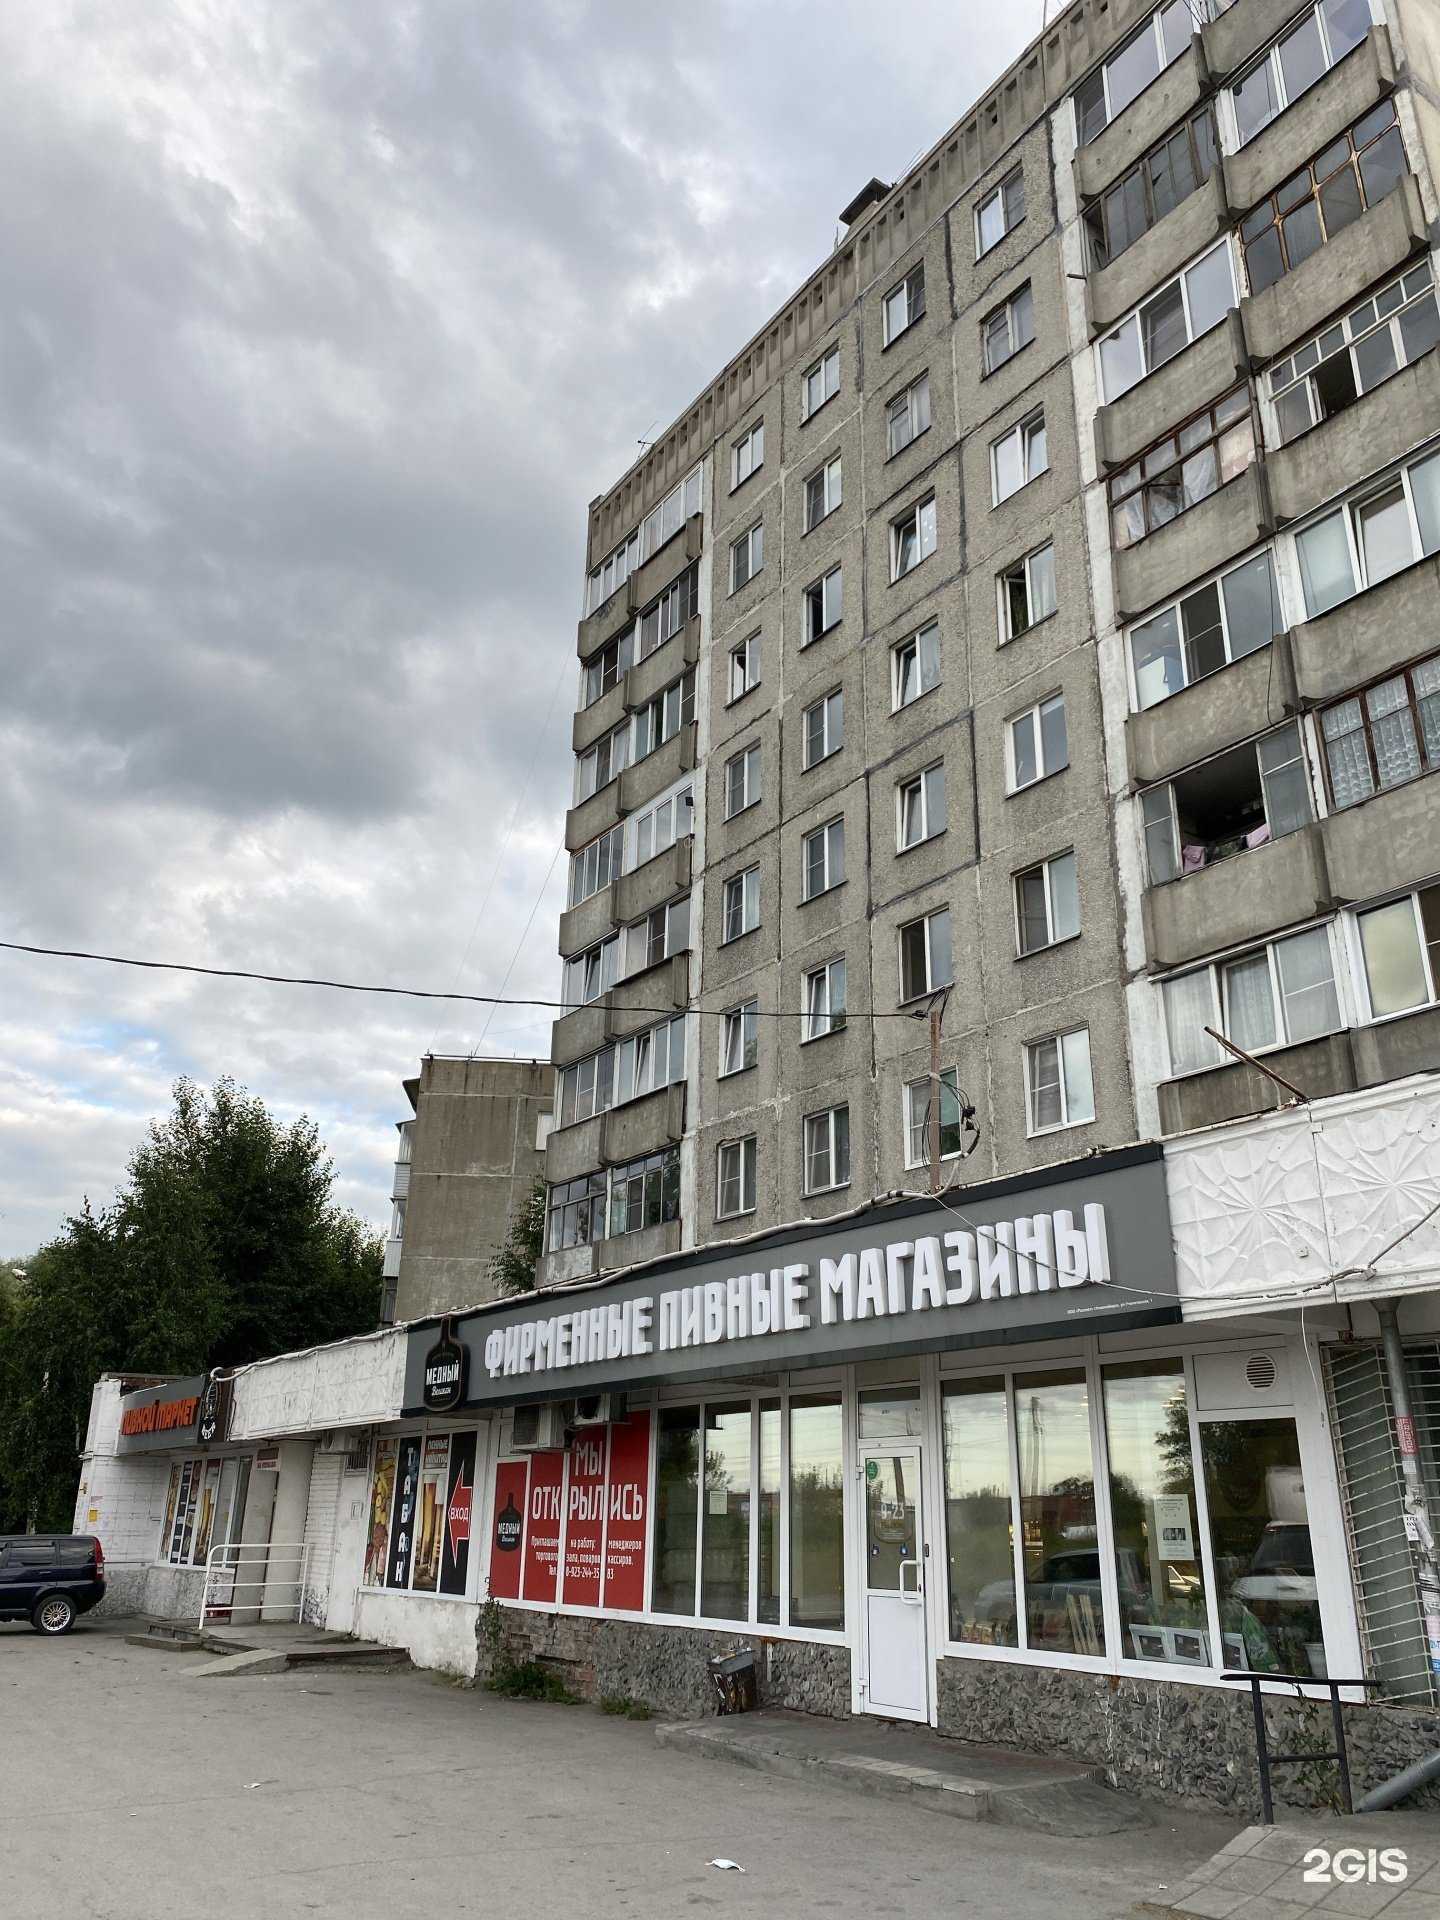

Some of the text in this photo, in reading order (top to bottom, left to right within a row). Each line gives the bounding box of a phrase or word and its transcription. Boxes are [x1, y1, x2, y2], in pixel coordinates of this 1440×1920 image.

[485, 1202, 1111, 1378] ФИРМЕННЫЕ ПИВНЫЕ МАГАЗИНЫ
[426, 1360, 460, 1386] МЕДНЫЙ
[575, 1440, 603, 1476] МЫ
[450, 1507, 469, 1523] ВХОД
[532, 1484, 643, 1520] ОТКРЫЛИСЬ
[498, 1520, 520, 1534] МЕДНЫЙ
